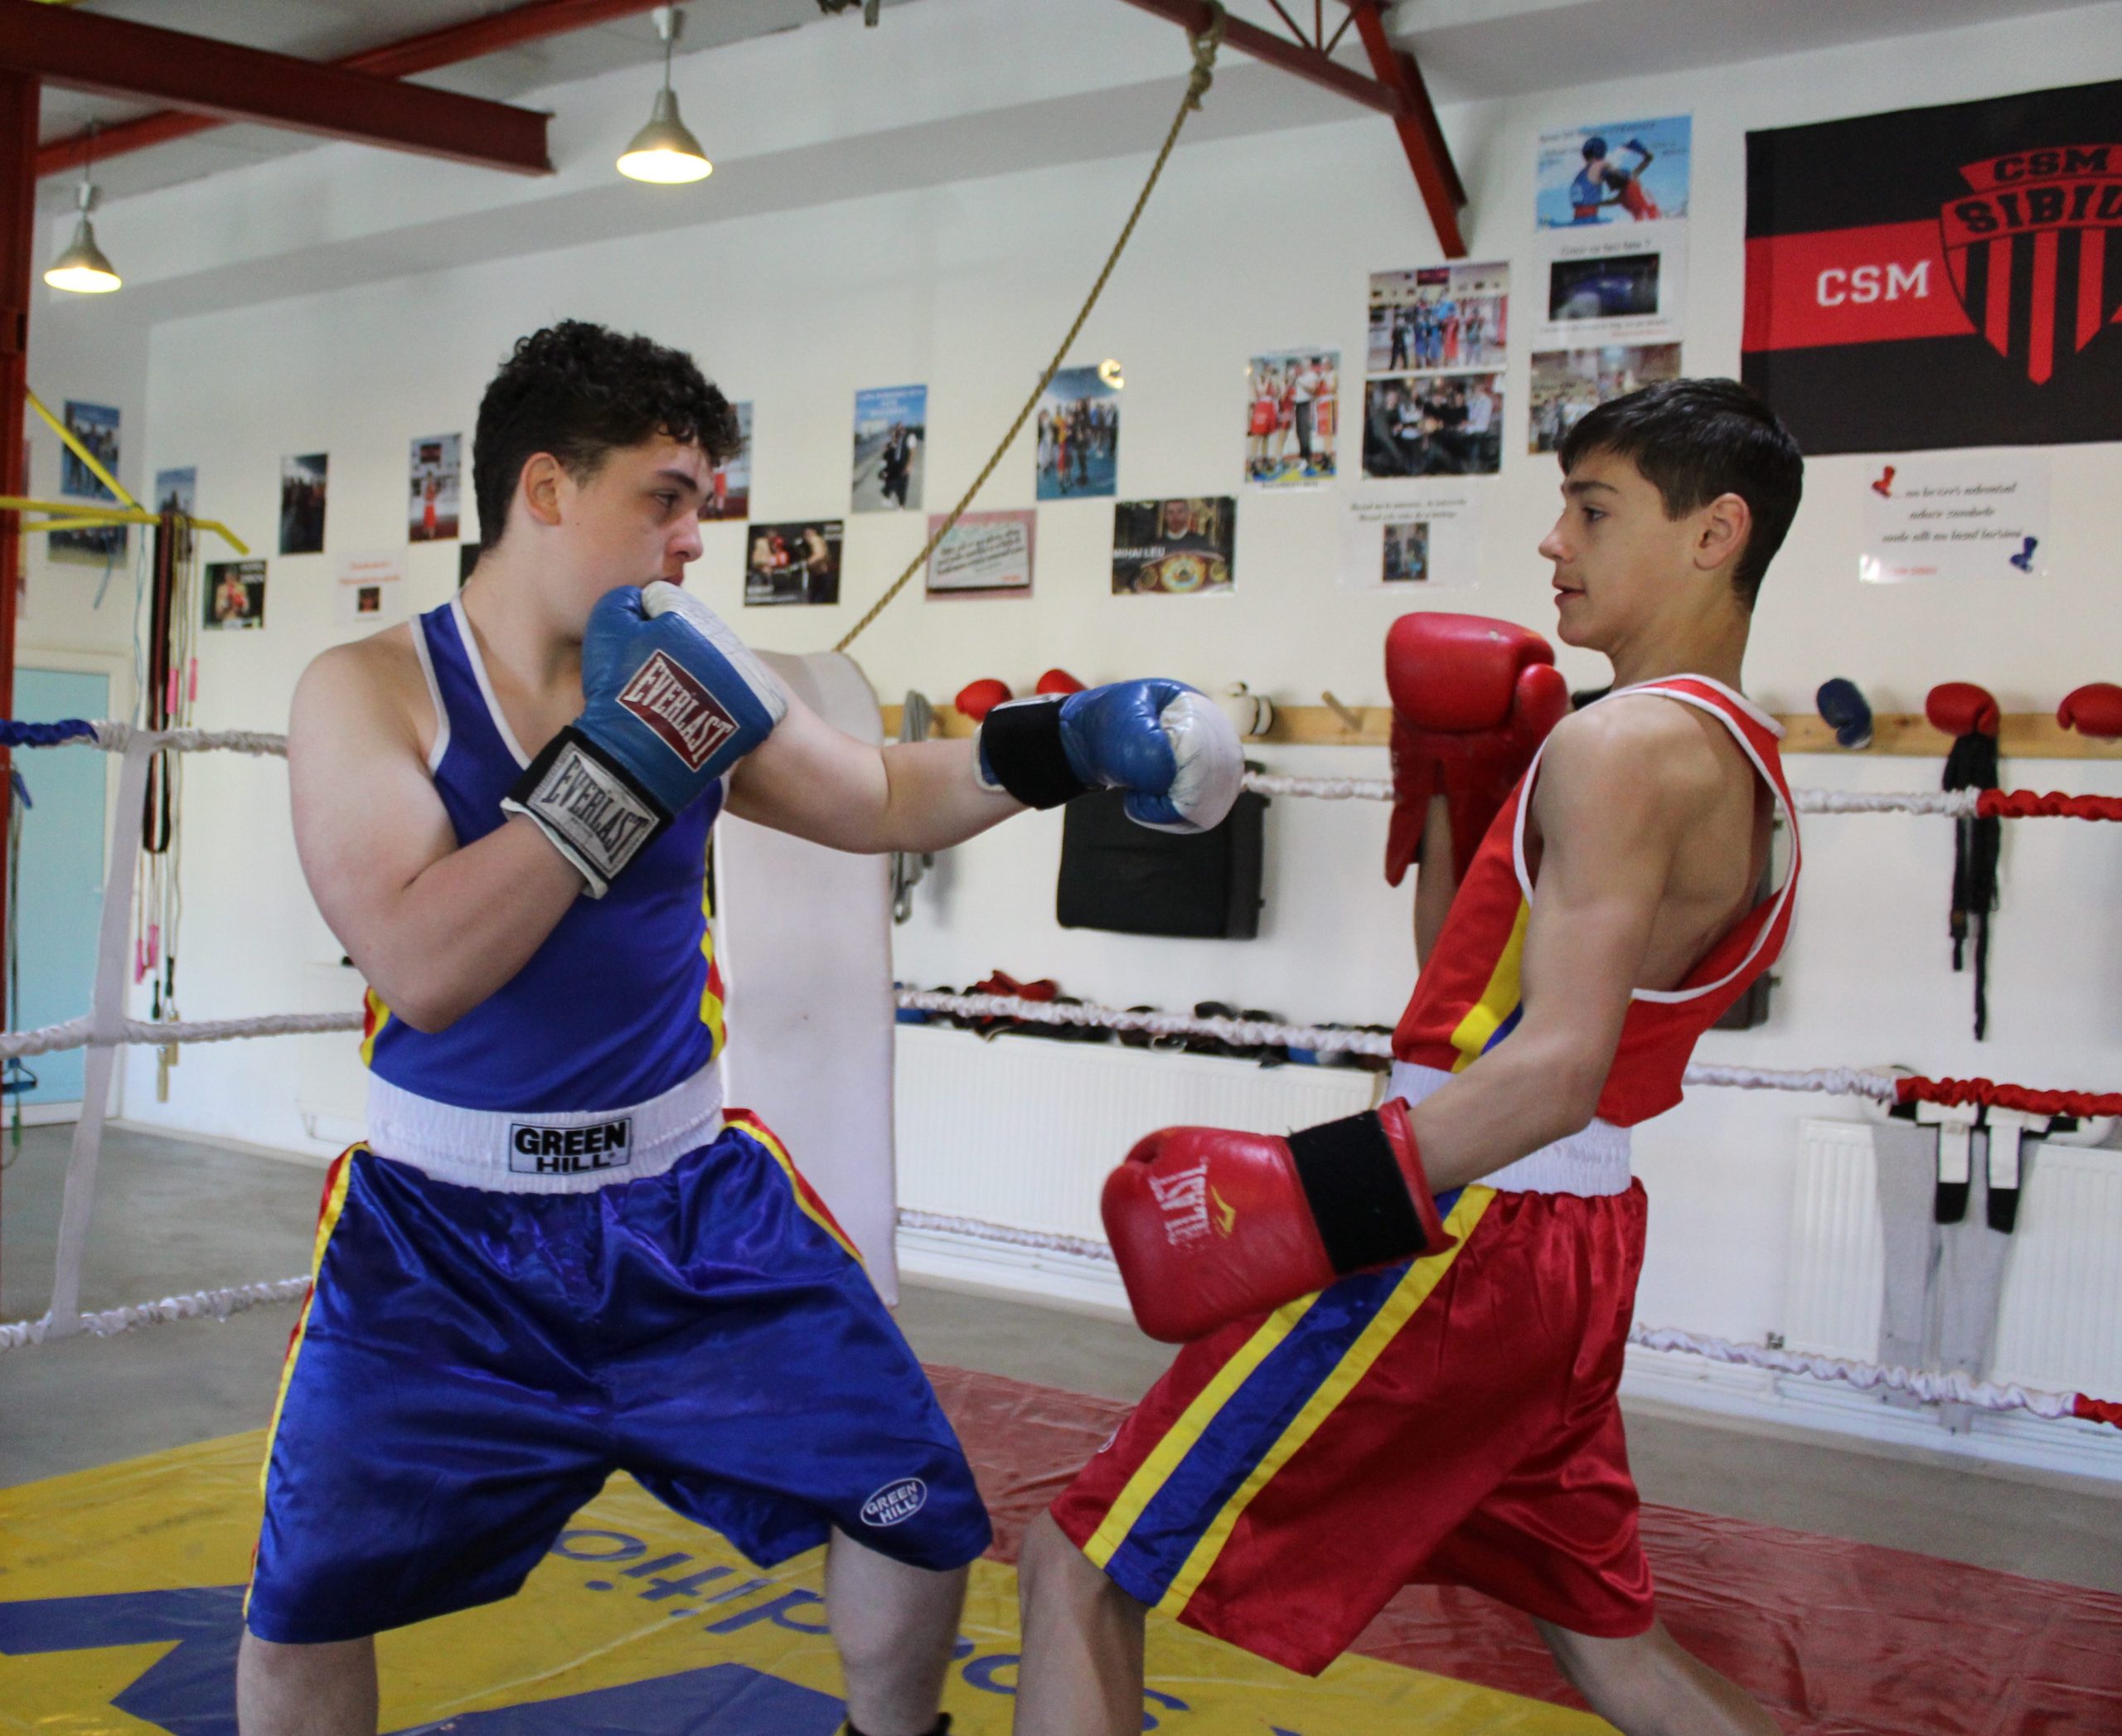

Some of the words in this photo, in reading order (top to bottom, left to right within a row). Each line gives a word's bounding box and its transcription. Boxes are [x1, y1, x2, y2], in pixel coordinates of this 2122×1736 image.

[1993, 147, 2112, 182] CSM
[1816, 259, 1931, 307] CSM
[623, 655, 734, 764] EVERLAST
[540, 754, 651, 864] EVERLAST
[514, 1121, 627, 1156] GREEN
[535, 1155, 612, 1172] HILL
[865, 1481, 918, 1515] GREEN
[879, 1500, 918, 1524] HILL
